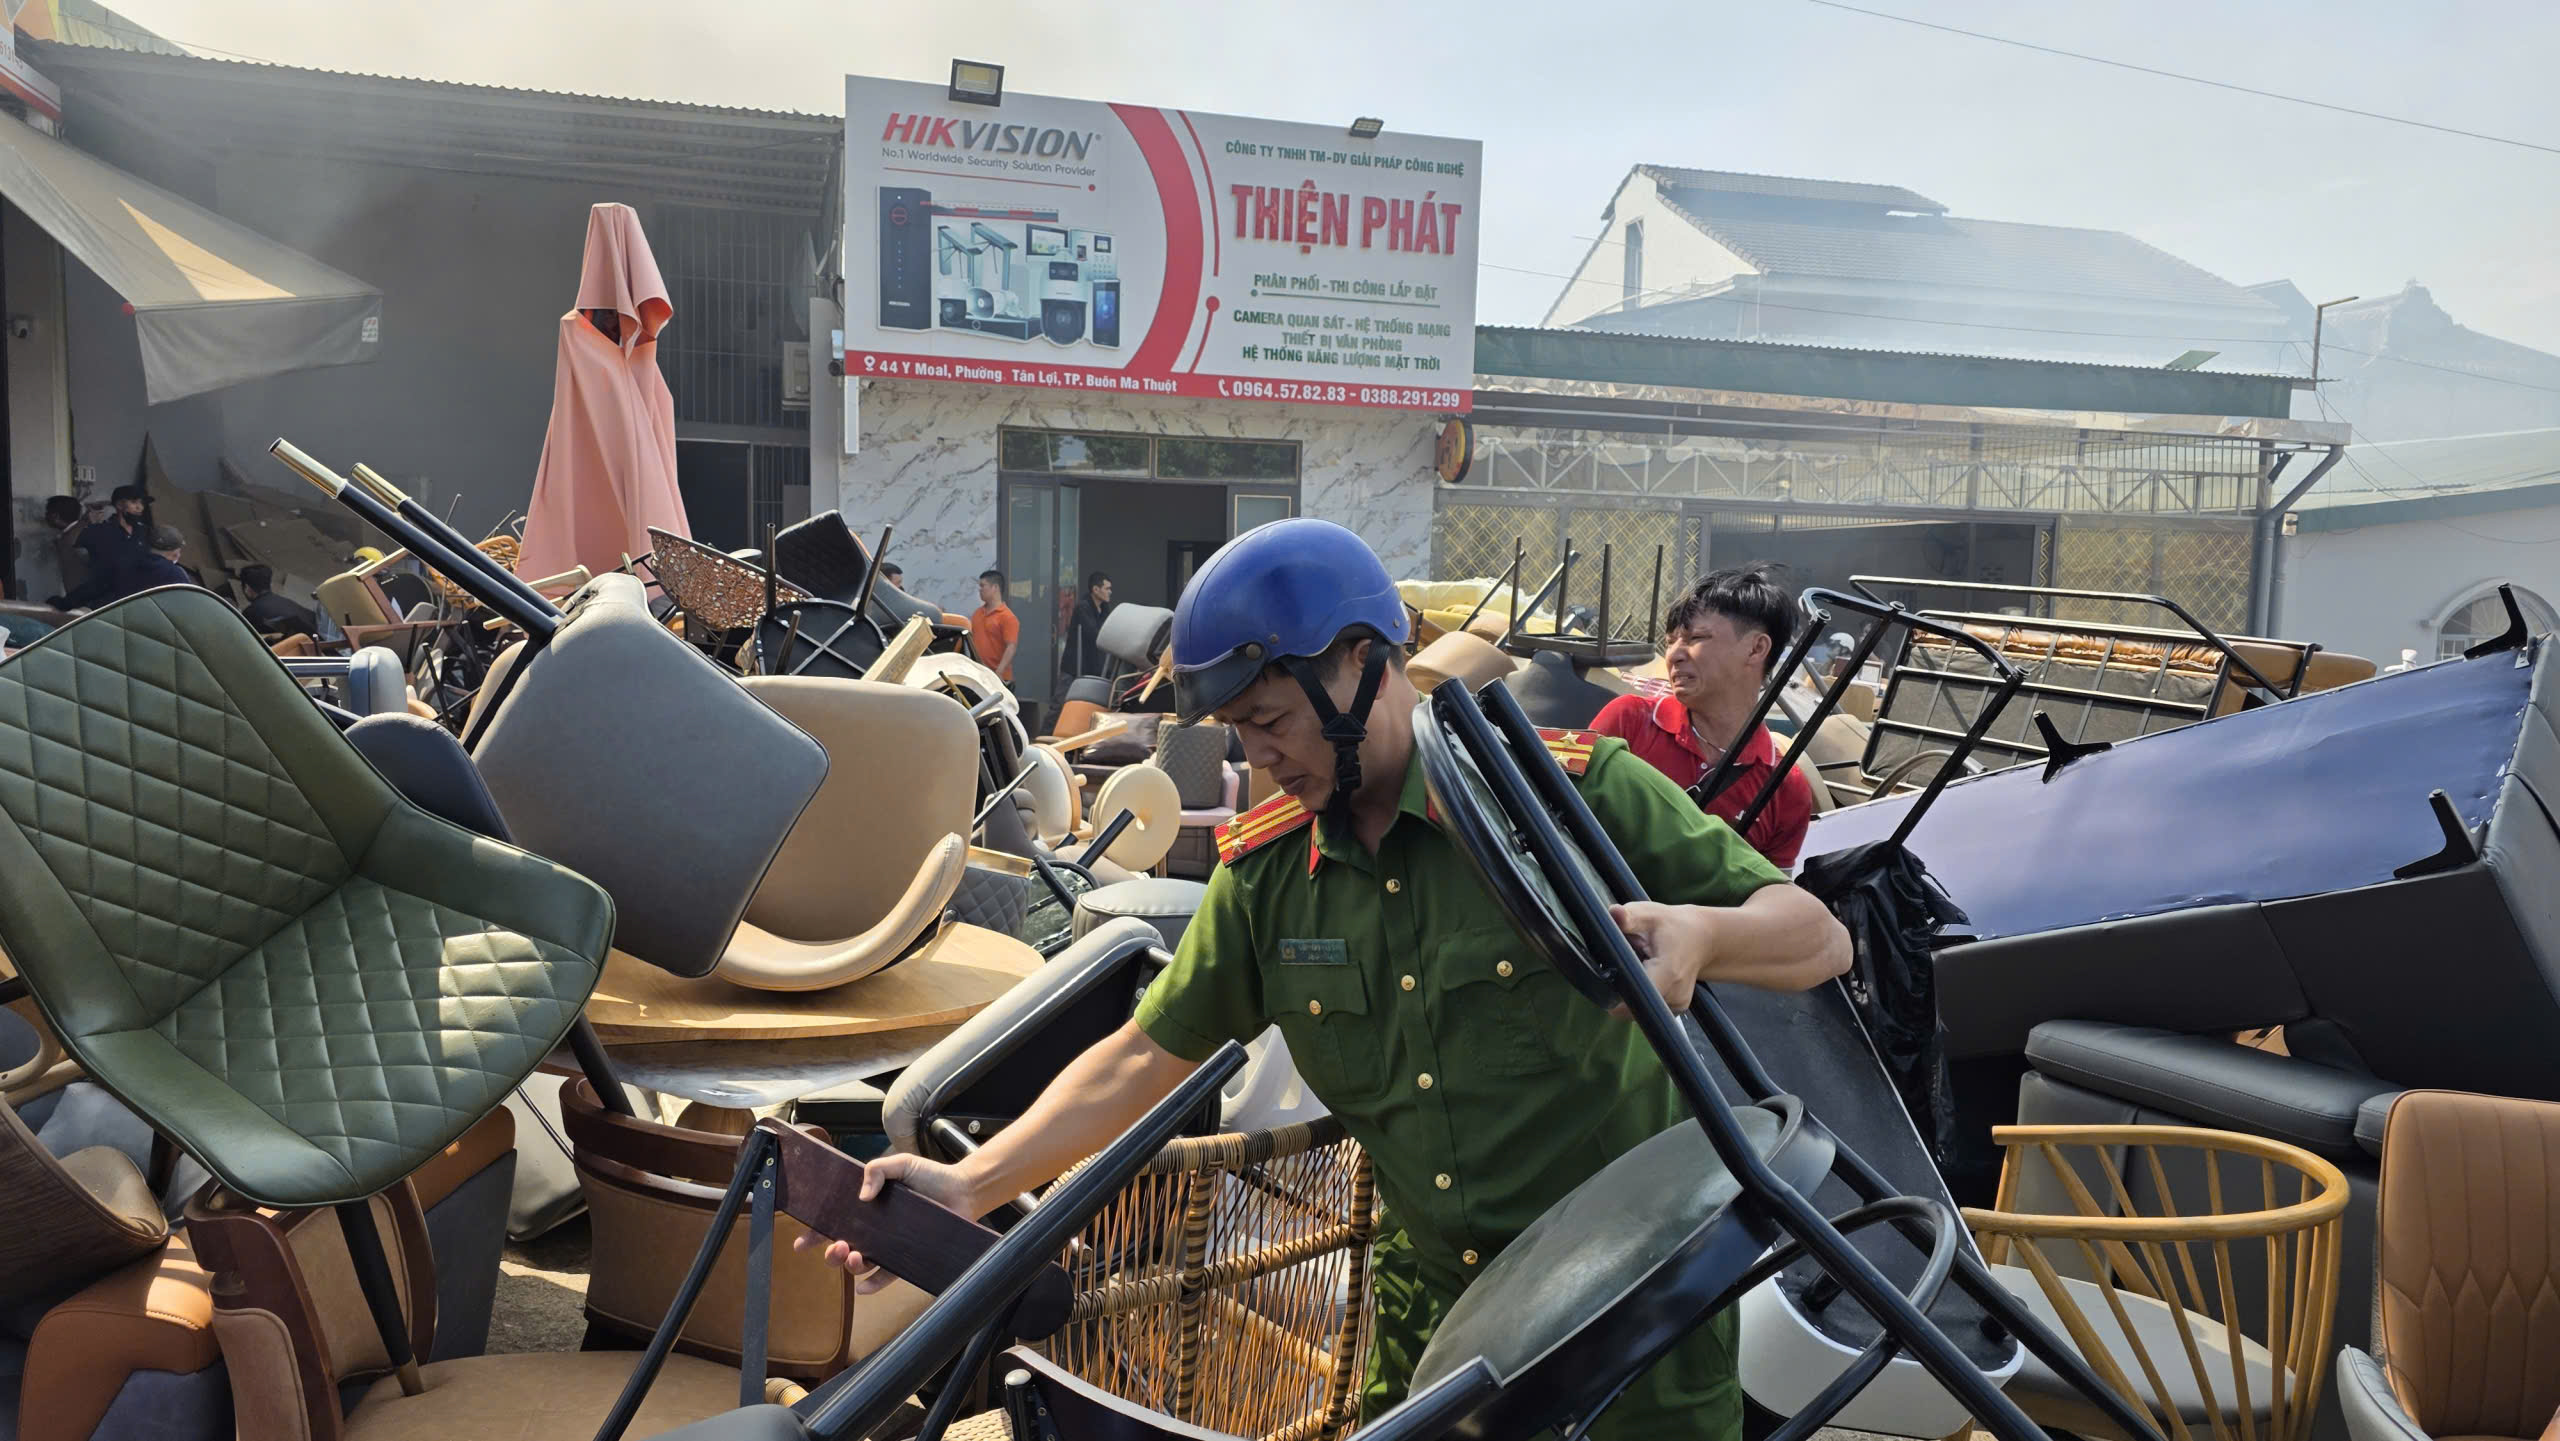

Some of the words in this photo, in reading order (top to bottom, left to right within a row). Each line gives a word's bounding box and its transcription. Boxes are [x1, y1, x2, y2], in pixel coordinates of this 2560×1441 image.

[881, 112, 1093, 160] HIKVISION
[881, 148, 904, 160] No.1
[907, 149, 963, 165] Worldwide
[967, 157, 1009, 170] Security
[1012, 160, 1052, 172] Solution
[1055, 164, 1096, 177] Provider
[1225, 140, 1256, 156] CÔNG
[1259, 145, 1274, 157] TY
[1277, 147, 1306, 160] TNHH
[1350, 152, 1371, 167] GIẢI
[1374, 155, 1402, 169] PHÁP
[1405, 158, 1434, 172] CÔNG
[1436, 161, 1464, 178] NGHỆ
[1231, 179, 1350, 254] THIỆN
[1360, 190, 1462, 256] PHÁT
[1254, 273, 1287, 289] PHÂN
[1291, 274, 1319, 291] PHỐI
[1329, 280, 1349, 293] THI
[1352, 280, 1385, 296] CÔNG
[1234, 309, 1284, 325] CAMERA
[1287, 314, 1319, 328] QUAN
[1323, 315, 1345, 329] SÁT
[1355, 317, 1370, 334] HỆ
[1375, 317, 1413, 334] THỐNG
[1417, 322, 1451, 339] MẠNG
[1282, 329, 1316, 346] THIẾT
[1320, 334, 1332, 350] BỊ
[1362, 335, 1402, 351] PHÒNG
[1243, 344, 1258, 362] HỆ
[1263, 345, 1303, 362] THỐNG
[1307, 348, 1339, 364] NĂNG
[1343, 351, 1381, 369] LƯỢNG
[1384, 354, 1410, 371] MẶT
[1414, 355, 1440, 370] TRỜI
[879, 360, 898, 374] 44
[902, 362, 910, 375] Y
[914, 362, 951, 379] Moal,
[955, 365, 1002, 382] Phường
[1011, 369, 1035, 384] Tân
[1039, 371, 1061, 387] Lợi,
[1064, 372, 1083, 387] TP.
[1120, 376, 1140, 390] Ma
[1143, 377, 1177, 394] Thuột
[1233, 380, 1346, 402] 0964.57.82.83
[1360, 387, 1460, 409] 0388.291.299
